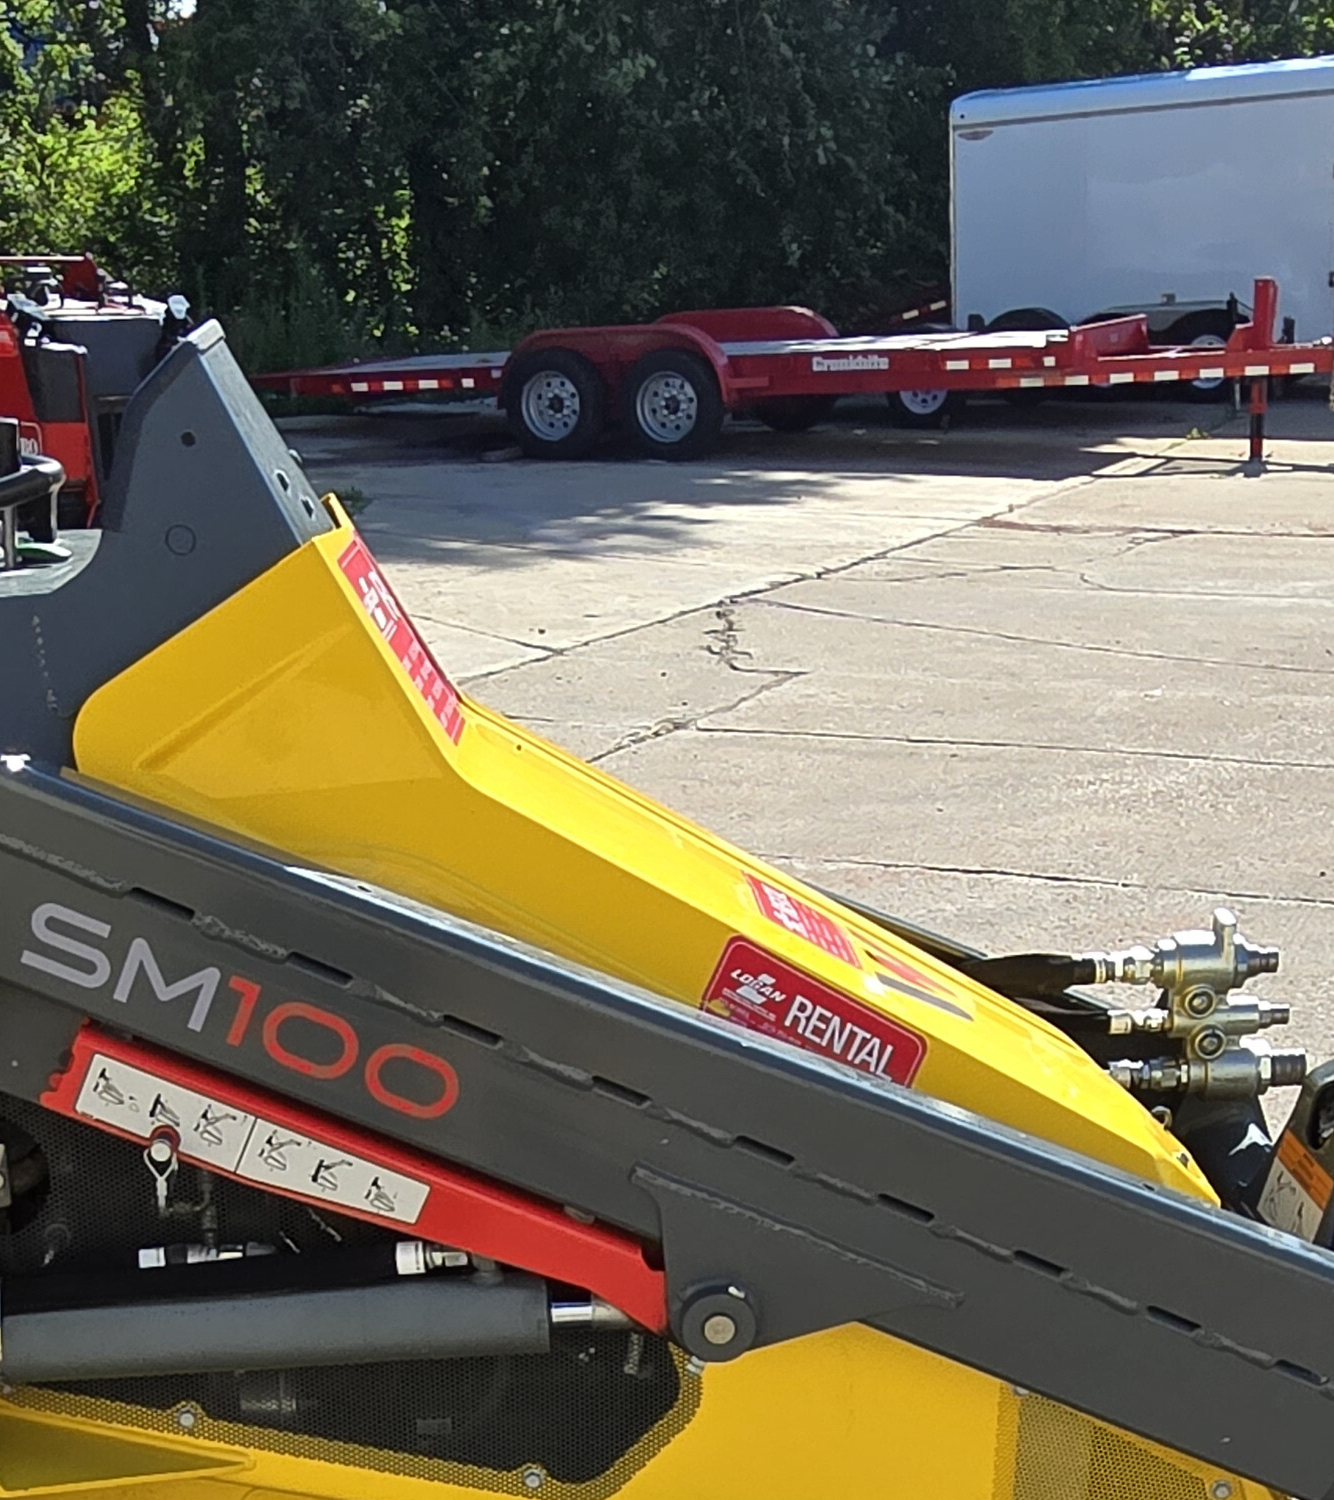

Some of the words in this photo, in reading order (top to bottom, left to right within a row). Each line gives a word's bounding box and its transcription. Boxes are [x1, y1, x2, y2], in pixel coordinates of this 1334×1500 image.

[20, 902, 460, 1119] SM100
[730, 969, 787, 1003] LOGAN
[784, 994, 894, 1083] RENTAL
